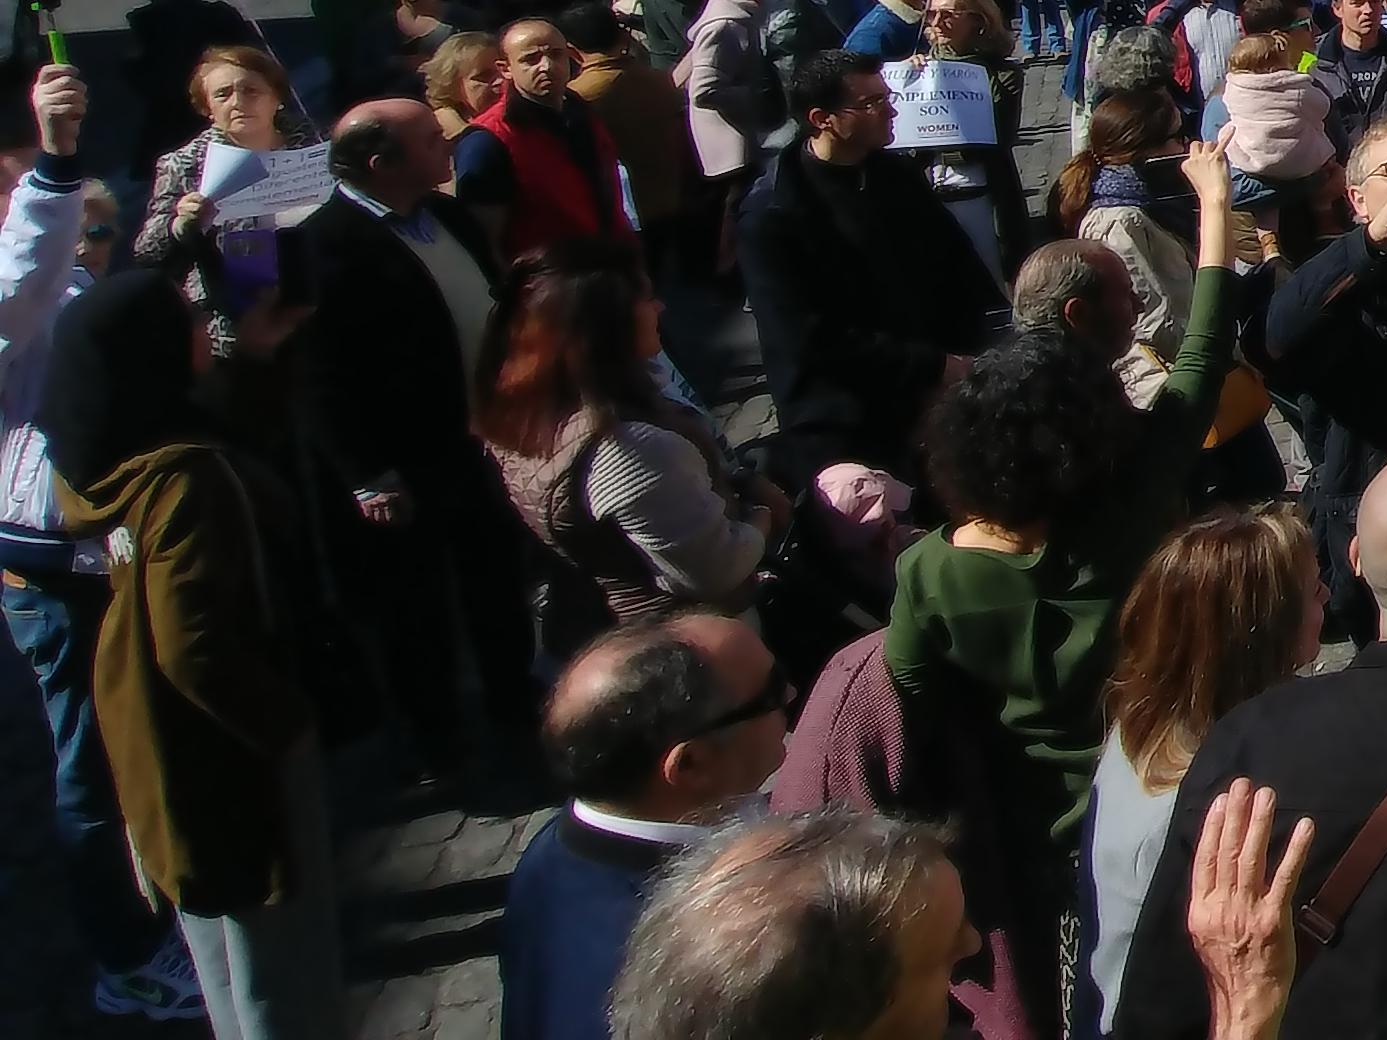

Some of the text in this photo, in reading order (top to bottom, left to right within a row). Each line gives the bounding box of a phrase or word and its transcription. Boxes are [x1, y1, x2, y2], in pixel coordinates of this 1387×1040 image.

[931, 69, 938, 78] Y
[899, 90, 984, 102] MPLEMENTO
[920, 105, 949, 116] SON
[917, 124, 959, 133] WOMEN
